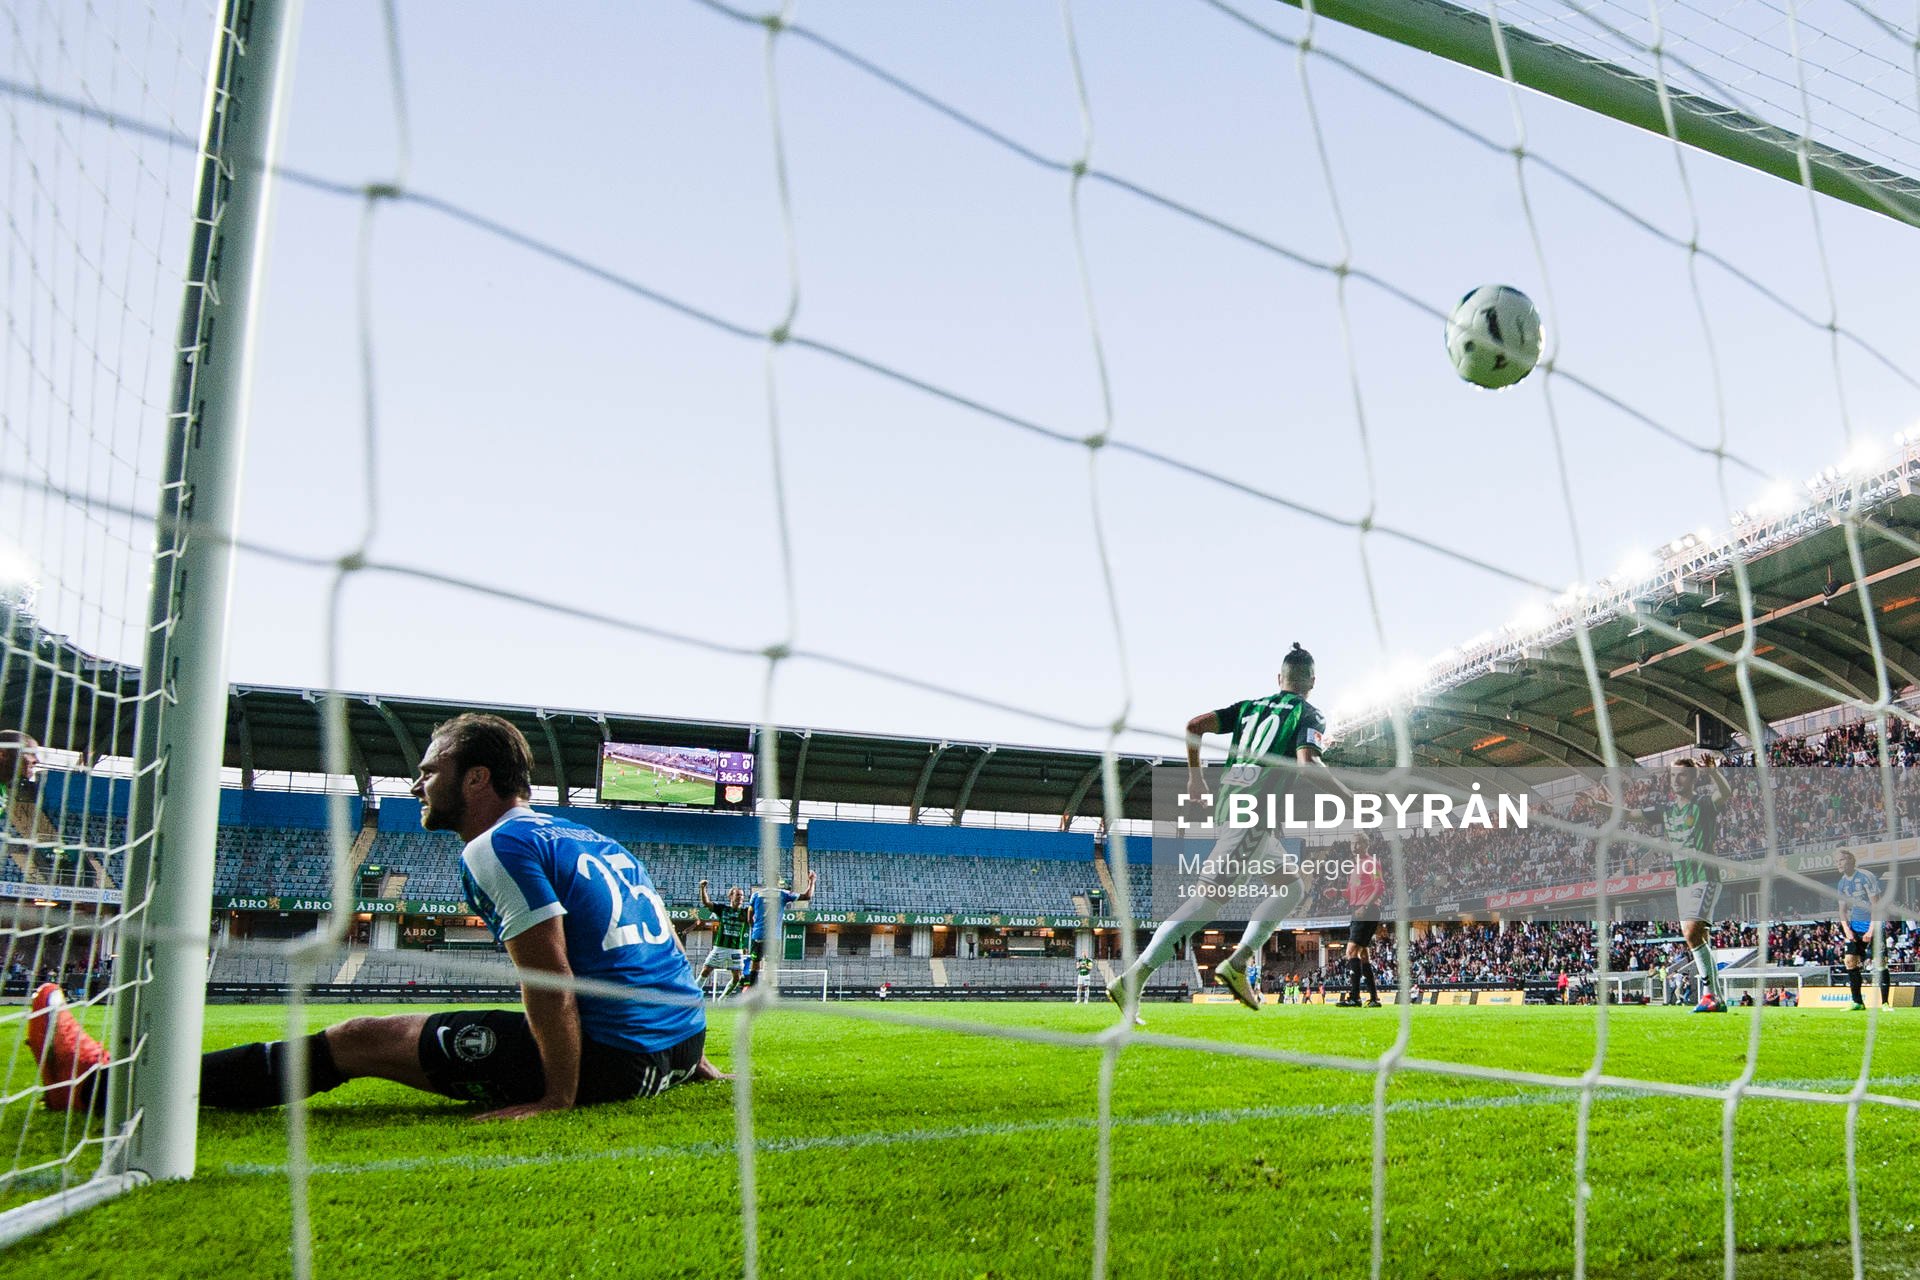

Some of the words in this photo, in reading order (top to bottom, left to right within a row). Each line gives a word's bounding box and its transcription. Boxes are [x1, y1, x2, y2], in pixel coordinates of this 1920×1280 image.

[1237, 712, 1280, 759] 10
[719, 771, 750, 782] 36:36
[720, 758, 728, 768] 0
[742, 760, 751, 770] 0
[577, 853, 671, 951] 25
